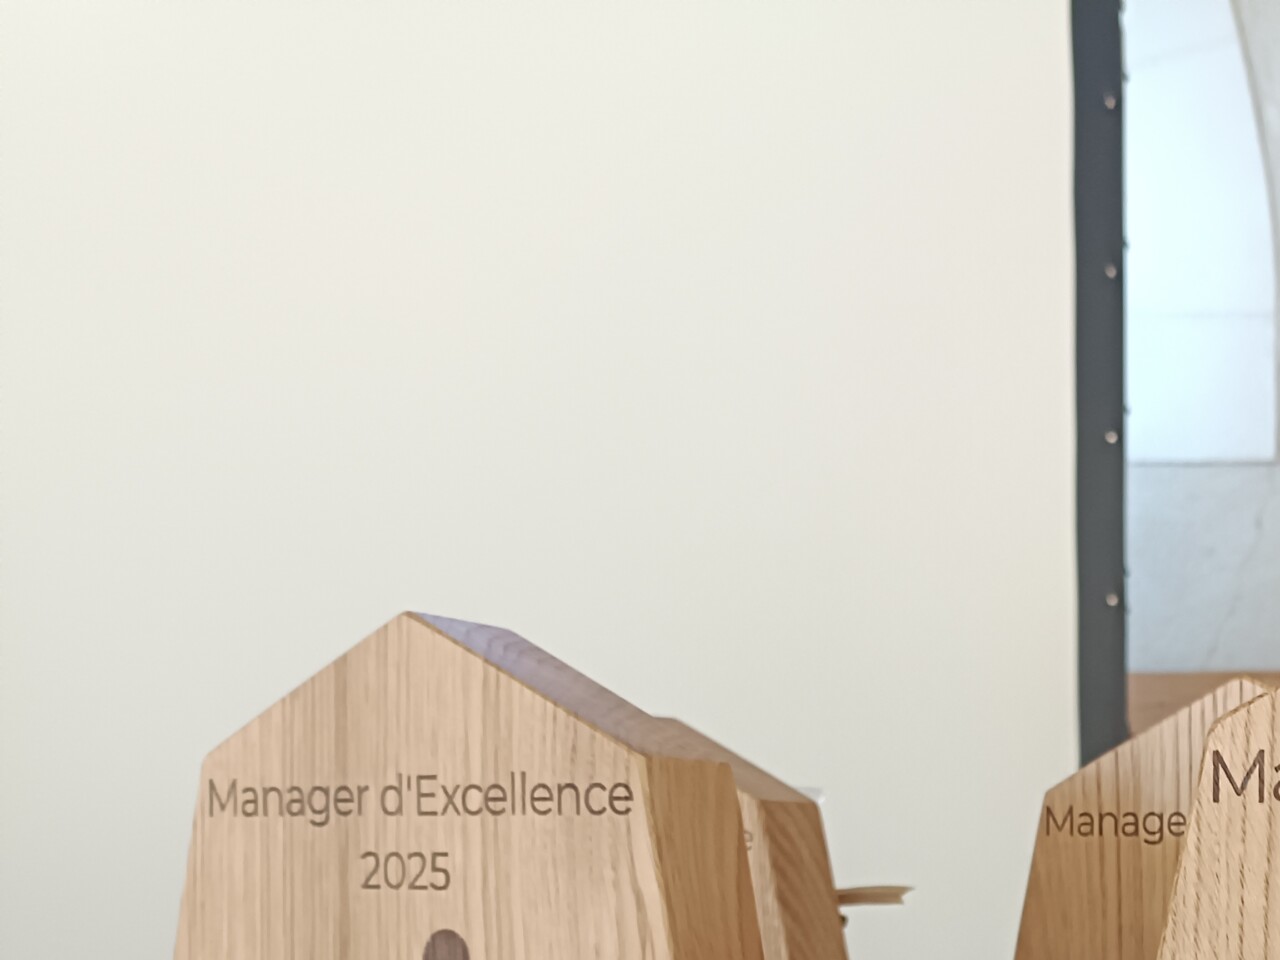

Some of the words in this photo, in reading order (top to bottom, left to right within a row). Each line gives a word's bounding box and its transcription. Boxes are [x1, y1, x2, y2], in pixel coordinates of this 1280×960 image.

[207, 778, 369, 828] Manager
[380, 771, 634, 817] d'Excellence
[1045, 804, 1187, 845] Manage
[360, 850, 451, 891] 2025
